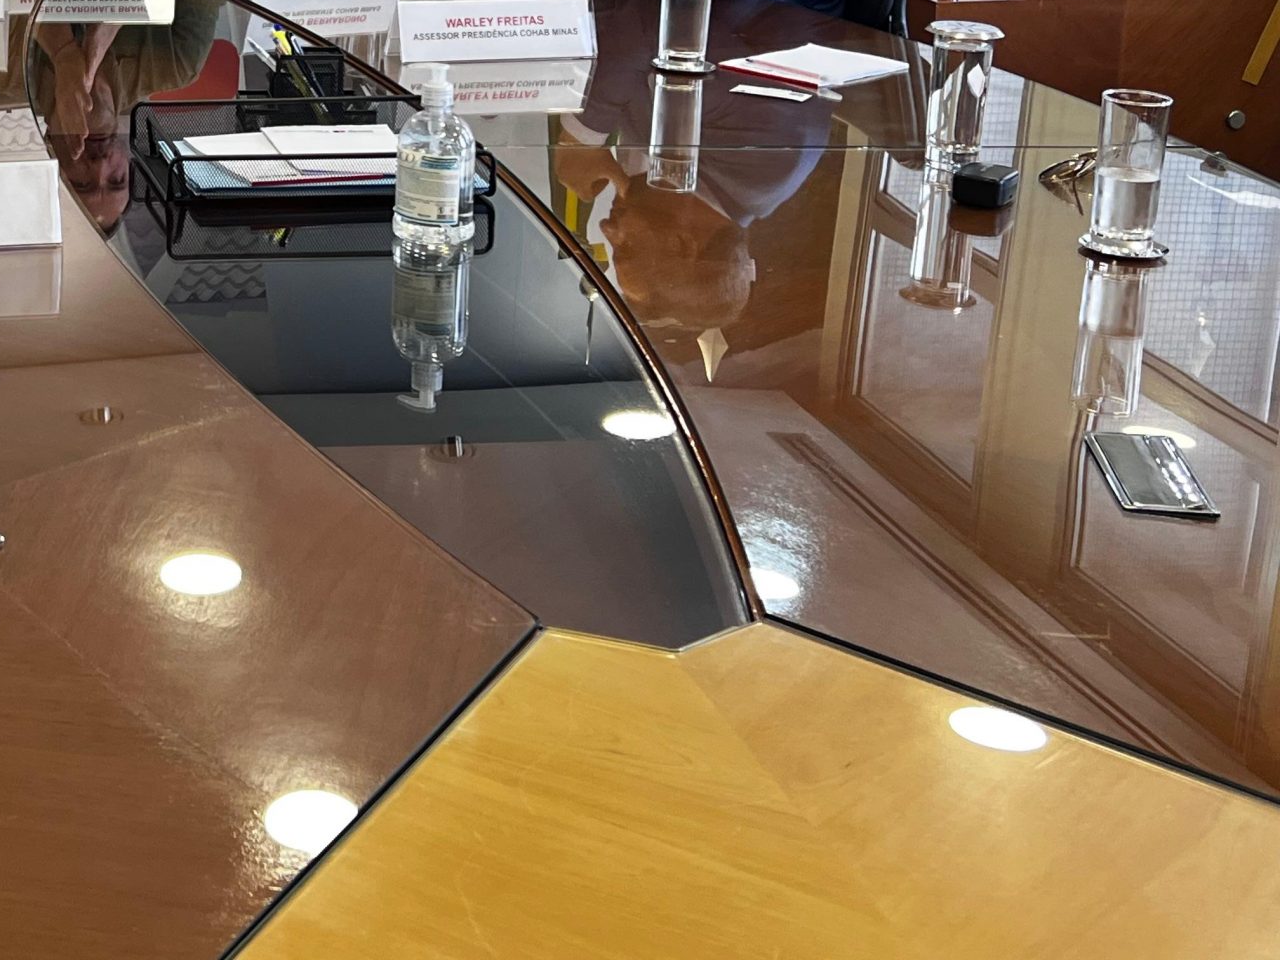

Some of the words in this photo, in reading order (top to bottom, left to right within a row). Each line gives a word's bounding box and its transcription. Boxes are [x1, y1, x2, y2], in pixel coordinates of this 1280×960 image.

[445, 17, 494, 28] WARLEY
[497, 15, 545, 26] FREITAS
[413, 32, 460, 41] ASSESSOR
[461, 29, 518, 39] PRESIDÊNCIA
[519, 28, 550, 37] COHAB
[552, 27, 578, 36] MINAS
